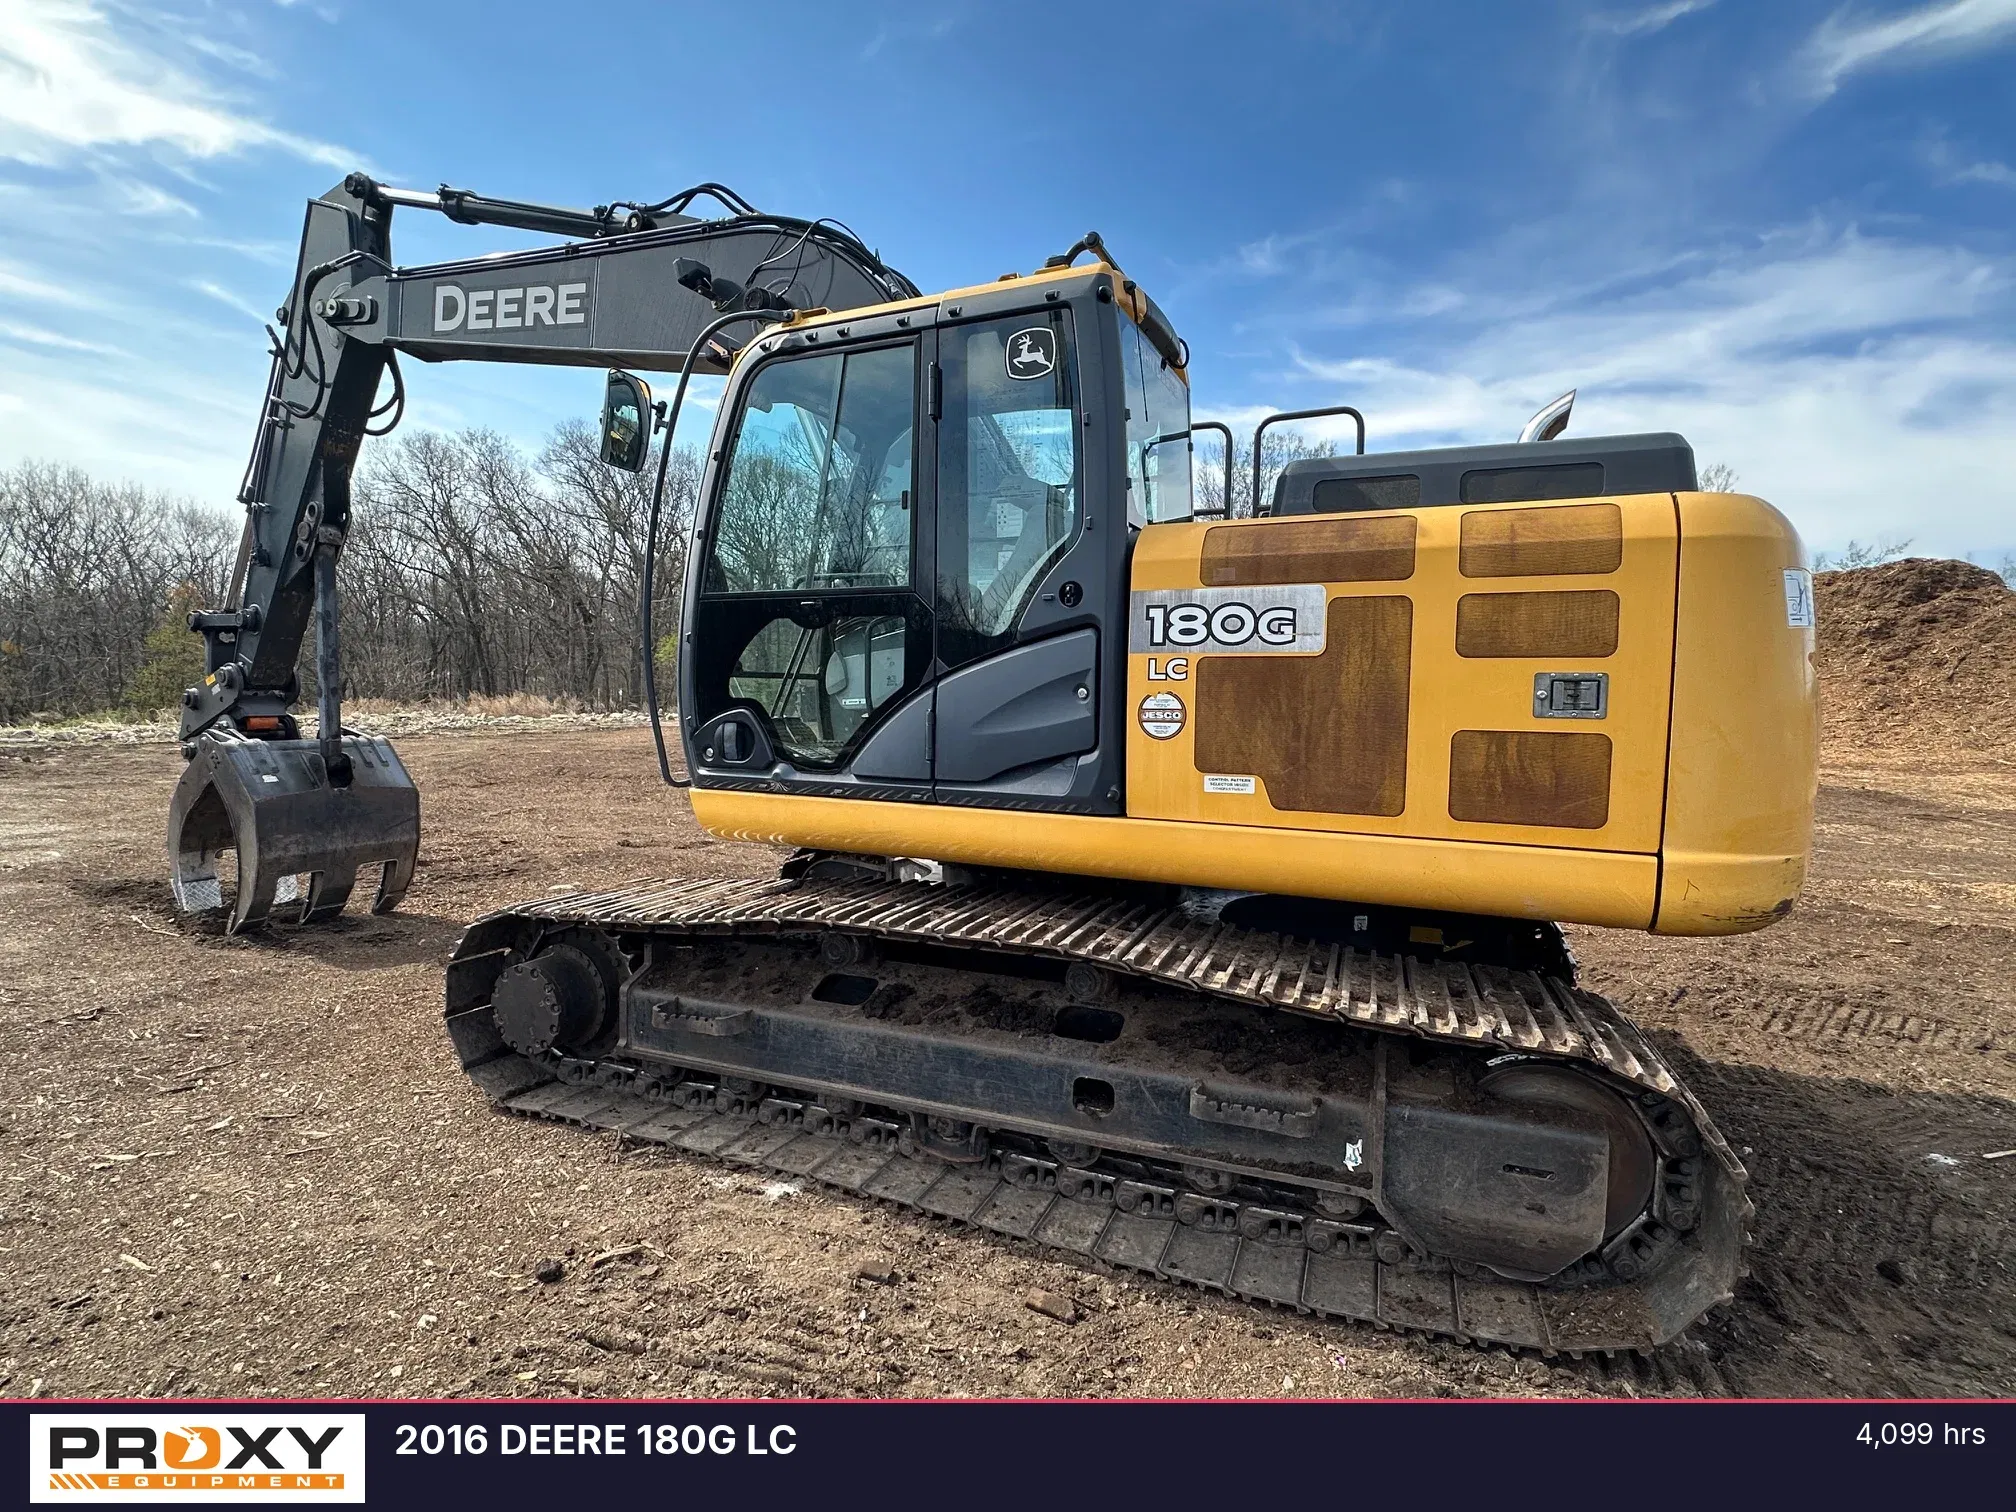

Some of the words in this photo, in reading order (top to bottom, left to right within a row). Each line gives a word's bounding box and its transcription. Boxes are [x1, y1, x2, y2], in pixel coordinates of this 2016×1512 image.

[434, 282, 587, 332] DEERE
[1146, 601, 1297, 647] 180G
[1147, 657, 1189, 681] LC
[1142, 711, 1182, 720] JESCO
